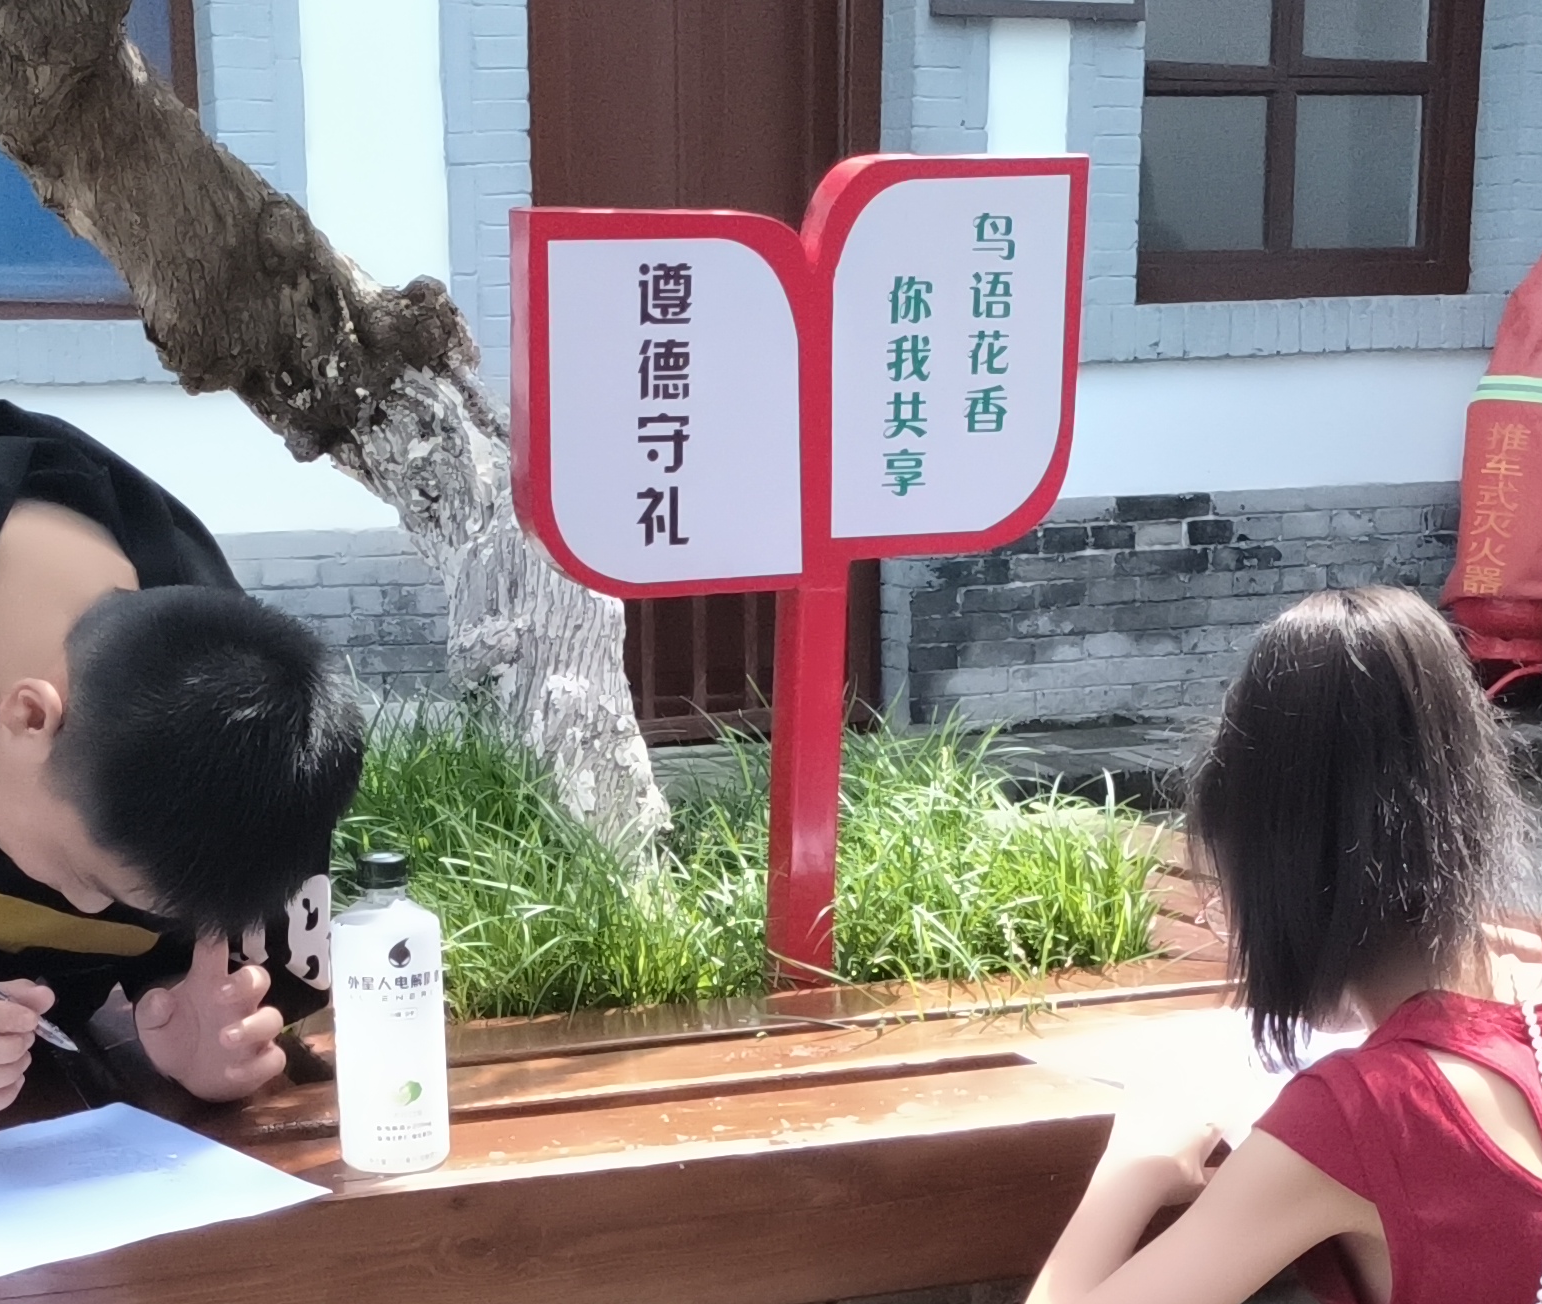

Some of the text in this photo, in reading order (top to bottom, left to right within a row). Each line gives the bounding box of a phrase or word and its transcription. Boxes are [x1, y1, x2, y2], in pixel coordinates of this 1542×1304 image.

[635, 262, 693, 549] 遵德守礼
[880, 274, 934, 497] 你我共享
[963, 211, 1016, 434] 鸟语花香
[1462, 421, 1532, 595] 推车式灭火器
